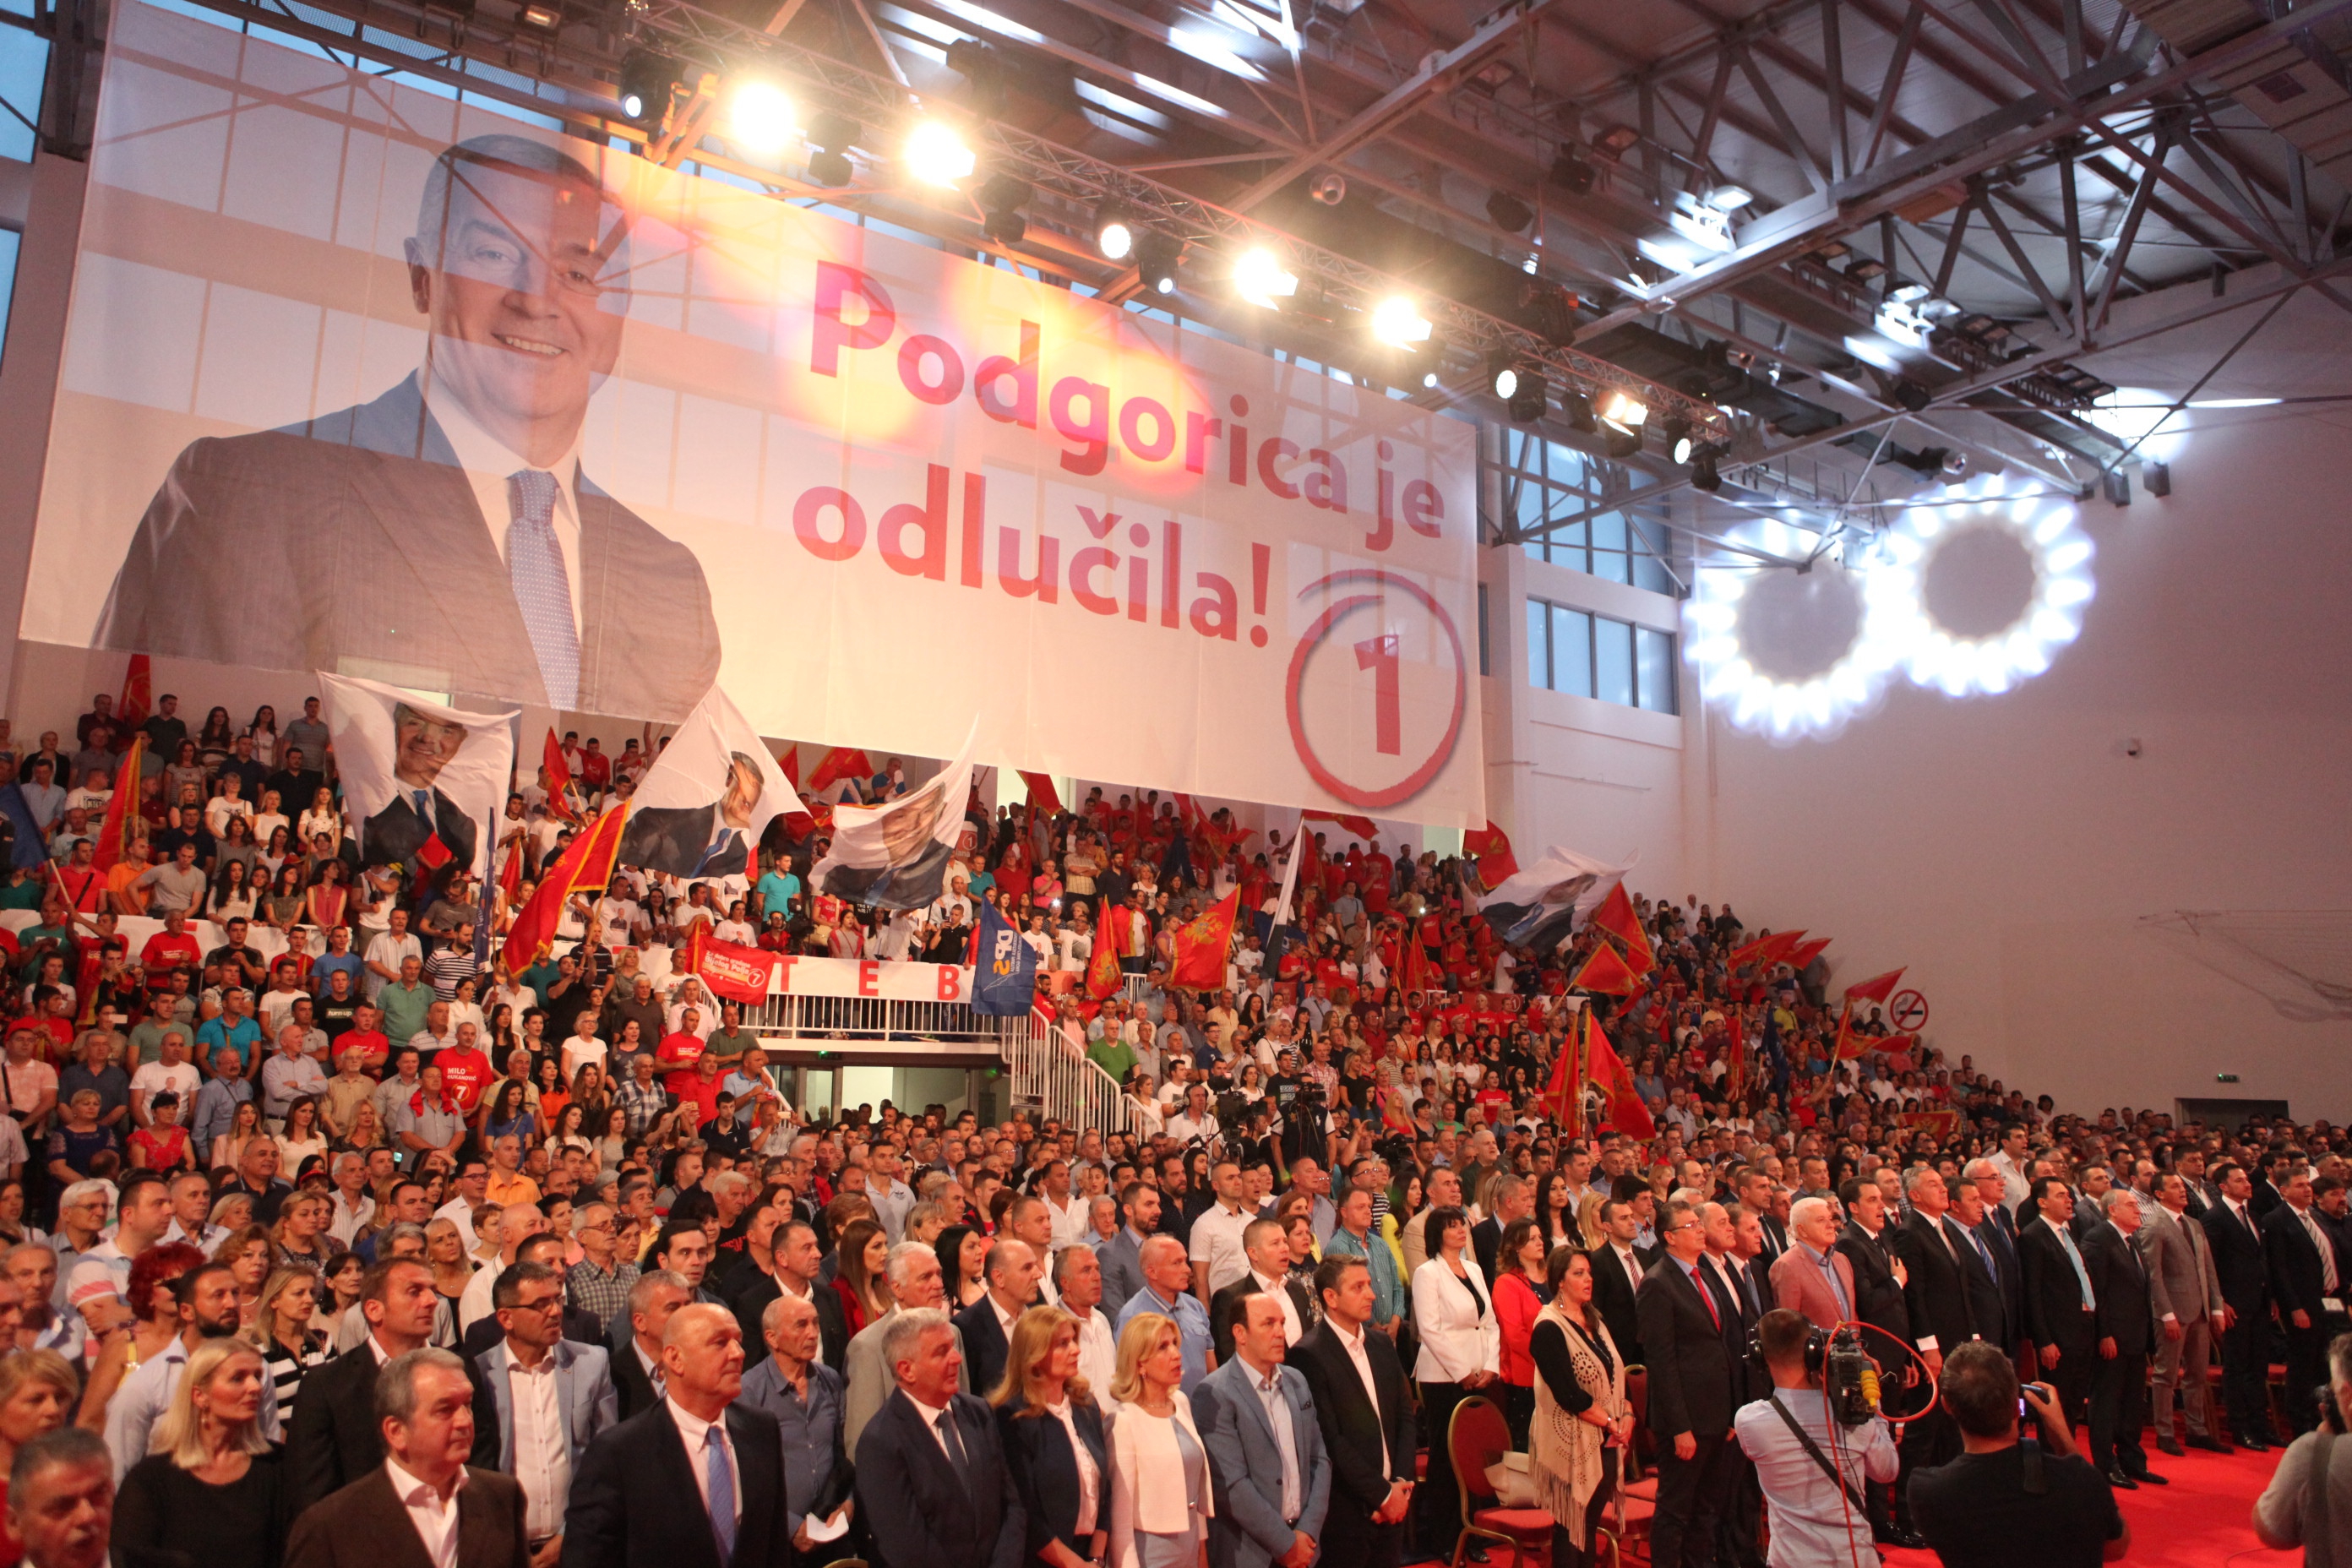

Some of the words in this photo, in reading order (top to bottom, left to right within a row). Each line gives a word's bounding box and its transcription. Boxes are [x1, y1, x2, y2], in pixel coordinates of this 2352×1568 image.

[810, 259, 1348, 514] Podgorica
[1365, 439, 1446, 552] je
[792, 463, 1271, 648] odlučila!
[1354, 634, 1401, 756] 1
[752, 972, 761, 985] 7
[456, 1086, 467, 1099] 7
